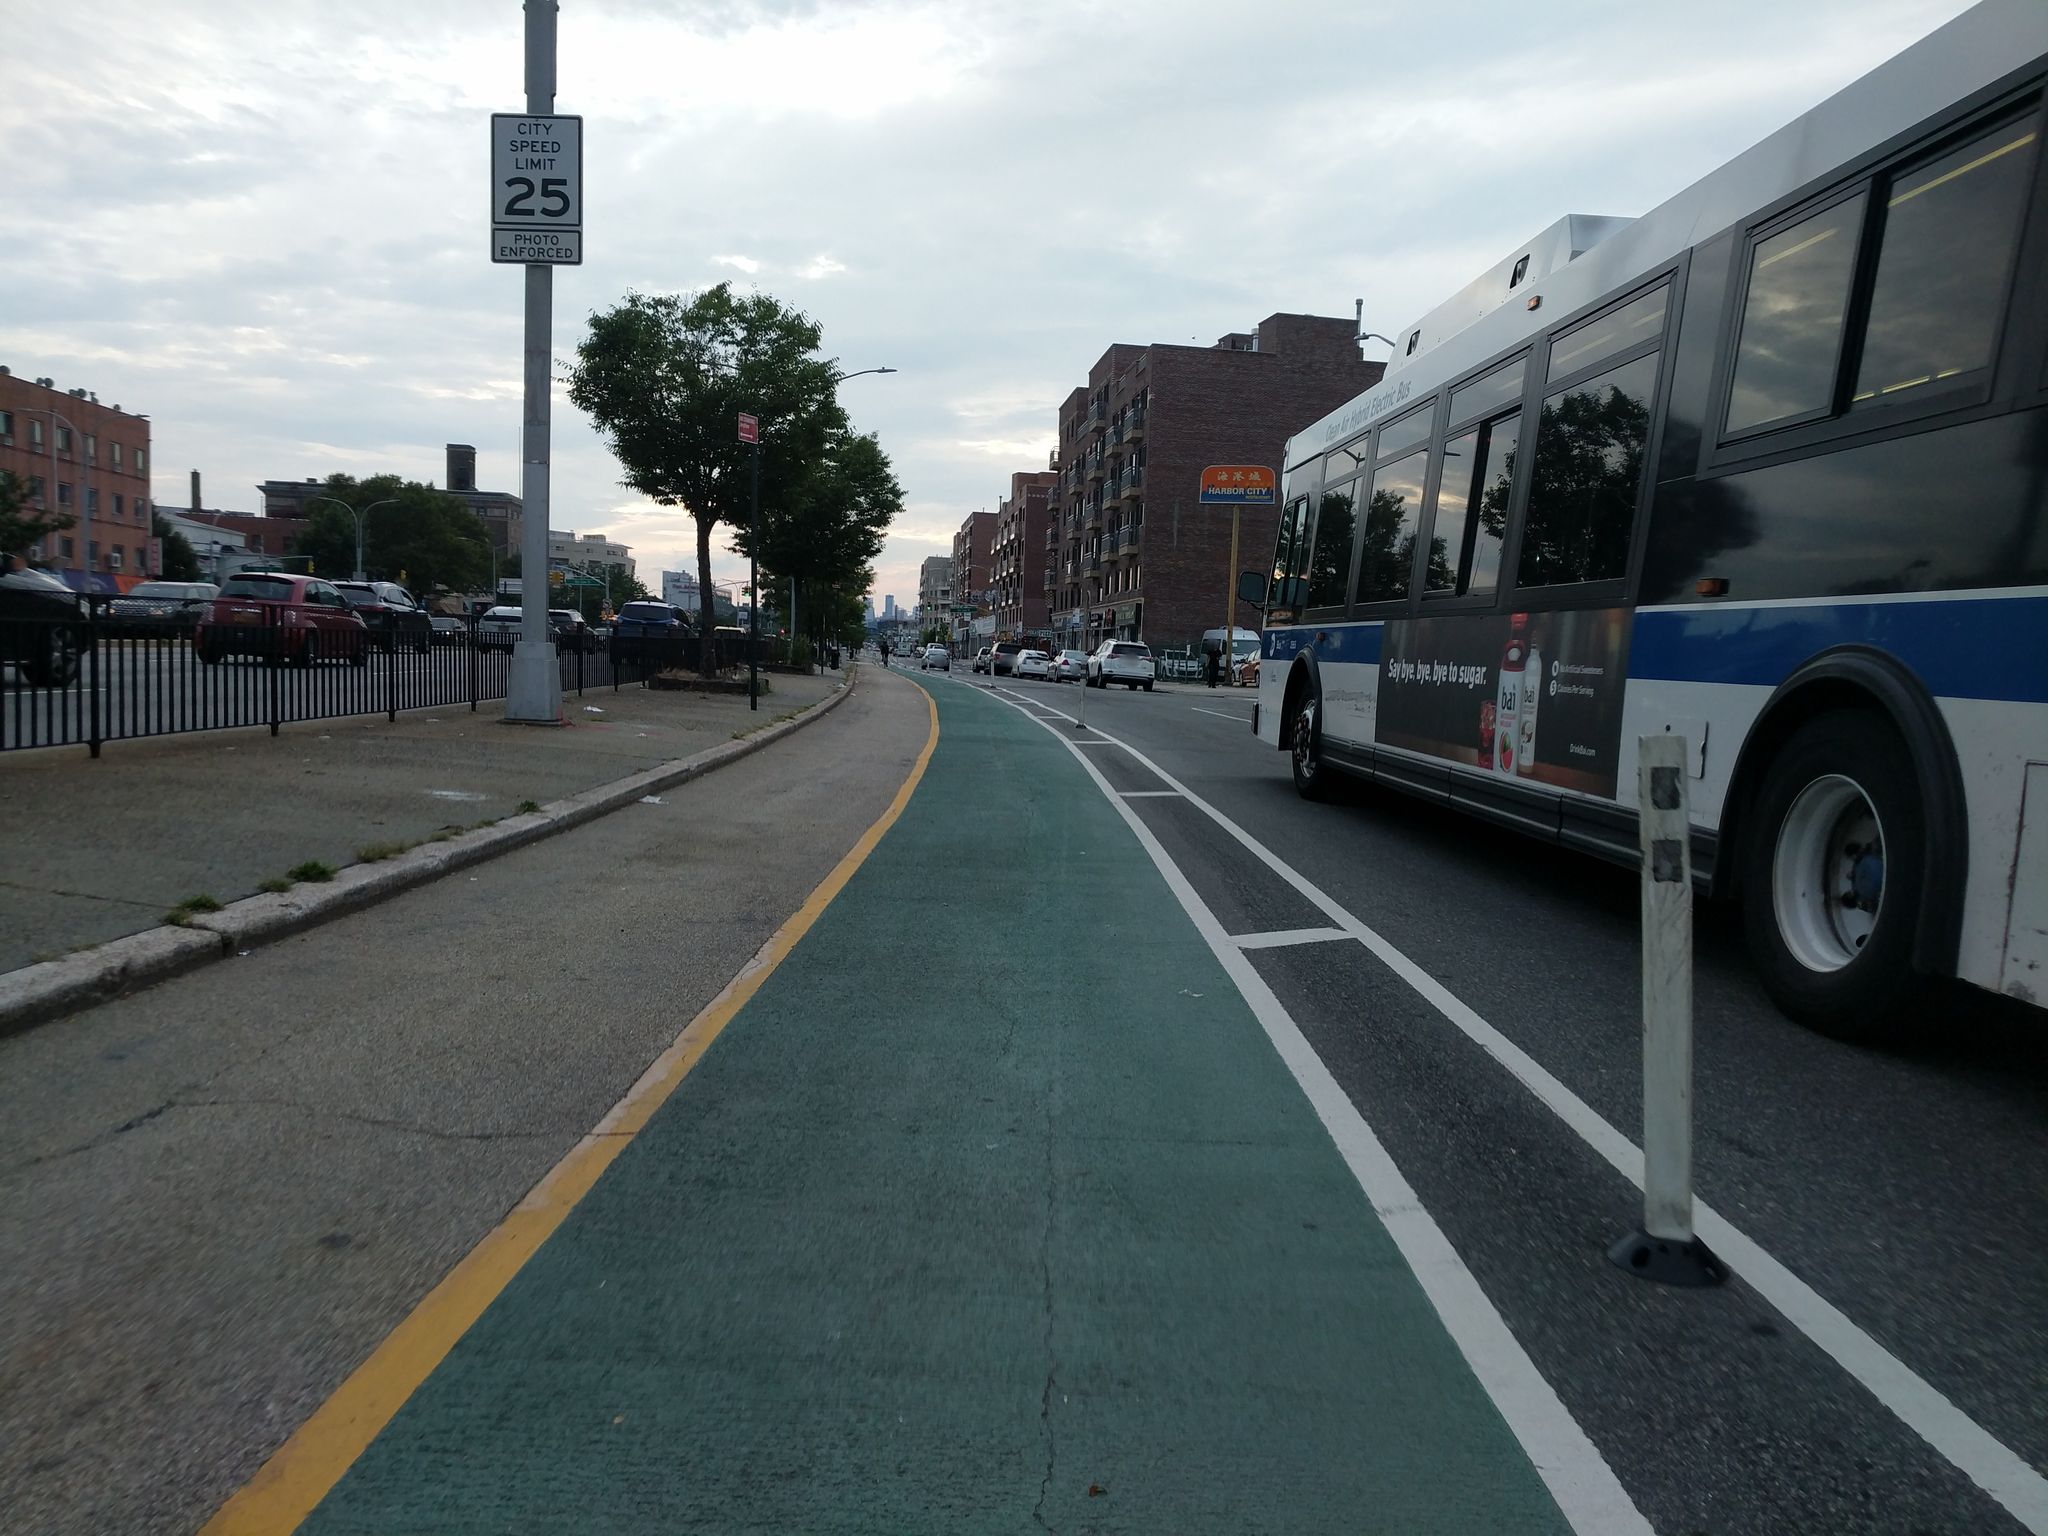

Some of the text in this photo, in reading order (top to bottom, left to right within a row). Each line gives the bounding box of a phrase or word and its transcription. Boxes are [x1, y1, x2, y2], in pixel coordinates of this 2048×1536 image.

[517, 122, 553, 136] CITY
[509, 140, 561, 153] SPEED
[515, 158, 556, 170] LIMIT
[504, 176, 570, 217] 25
[514, 234, 559, 246] PHOTO
[500, 246, 573, 259] ENFORCED
[1396, 381, 1412, 404] Bus
[1208, 487, 1268, 495] HARBOR CITY
[1388, 657, 1487, 689] Say bye, bye, bye to sugar.
[1501, 683, 1516, 711] bai
[1523, 685, 1535, 704] bai
